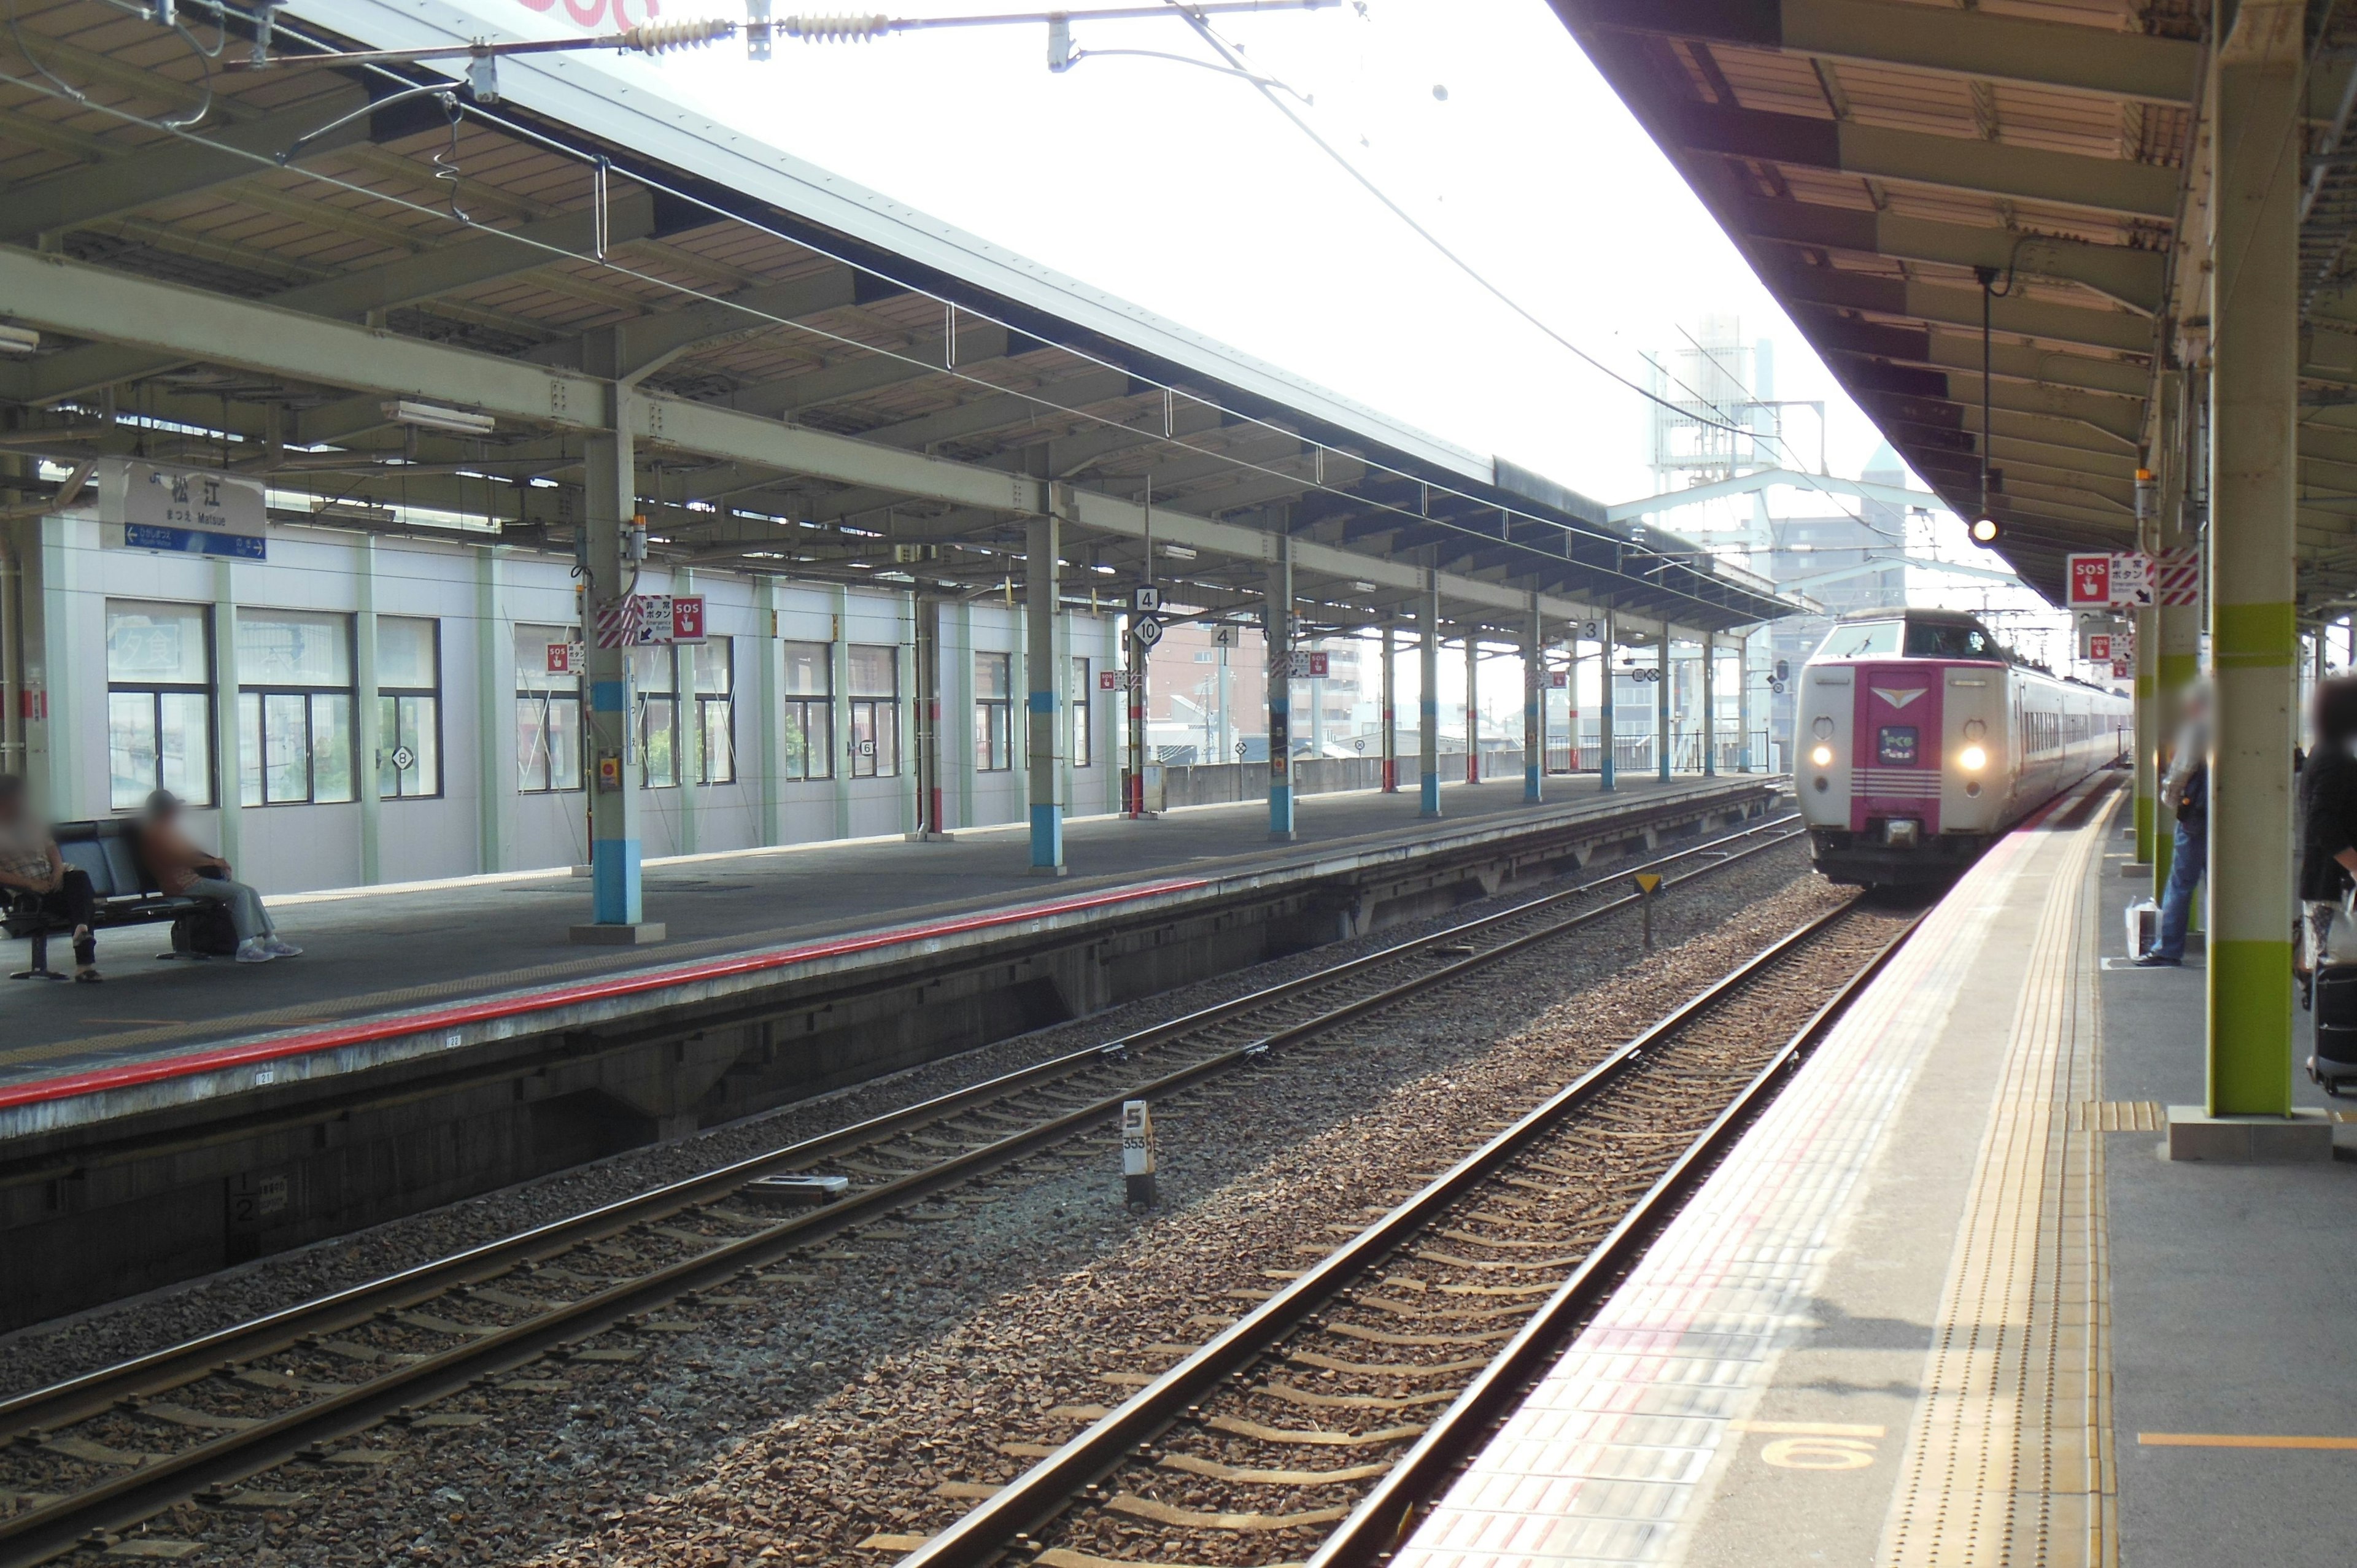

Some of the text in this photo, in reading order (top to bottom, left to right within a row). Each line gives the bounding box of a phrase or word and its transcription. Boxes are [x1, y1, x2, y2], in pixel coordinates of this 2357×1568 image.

[150, 472, 161, 484] JR
[171, 474, 220, 507] 松江
[166, 509, 226, 527] まつえ Matsue
[2076, 564, 2105, 576] SOS
[2113, 560, 2142, 569] 非常
[2113, 570, 2142, 579] ボタン
[1142, 592, 1153, 607] 4
[676, 604, 699, 614] SOS
[1142, 624, 1154, 638] 10
[1585, 622, 1596, 638] 3
[1218, 629, 1229, 644] 4
[864, 744, 870, 752] 6
[399, 752, 406, 763] 8
[451, 1037, 458, 1046] 22
[262, 1074, 269, 1083] 21
[1126, 1108, 1141, 1128] 5
[1123, 1137, 1145, 1149] 353
[236, 1199, 254, 1221] 2
